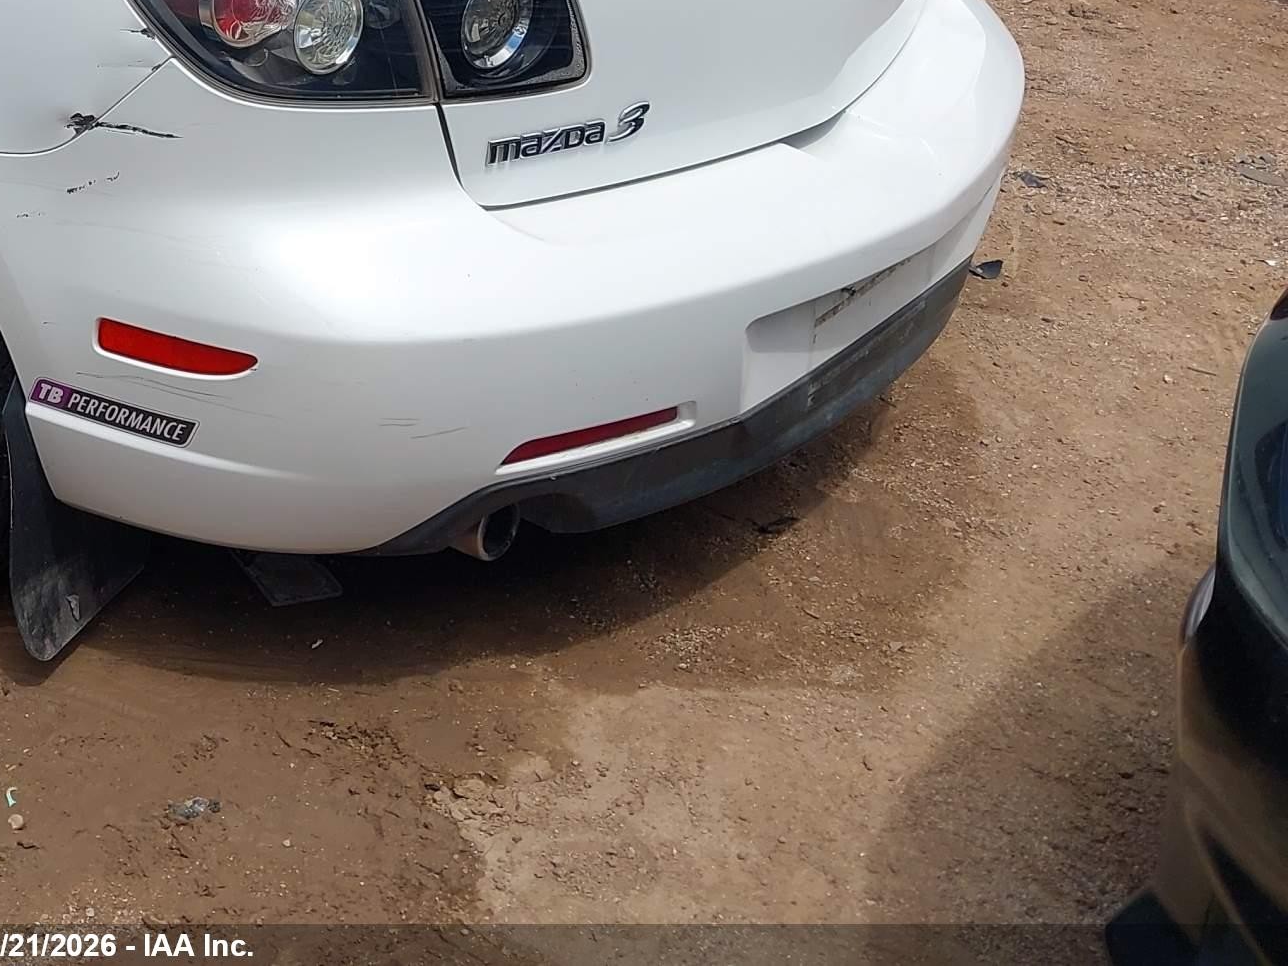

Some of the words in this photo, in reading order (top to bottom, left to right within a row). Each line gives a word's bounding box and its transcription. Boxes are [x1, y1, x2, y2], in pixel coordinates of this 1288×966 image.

[607, 101, 651, 144] 3
[38, 383, 64, 404] TB
[67, 392, 187, 441] PERFORMANCE
